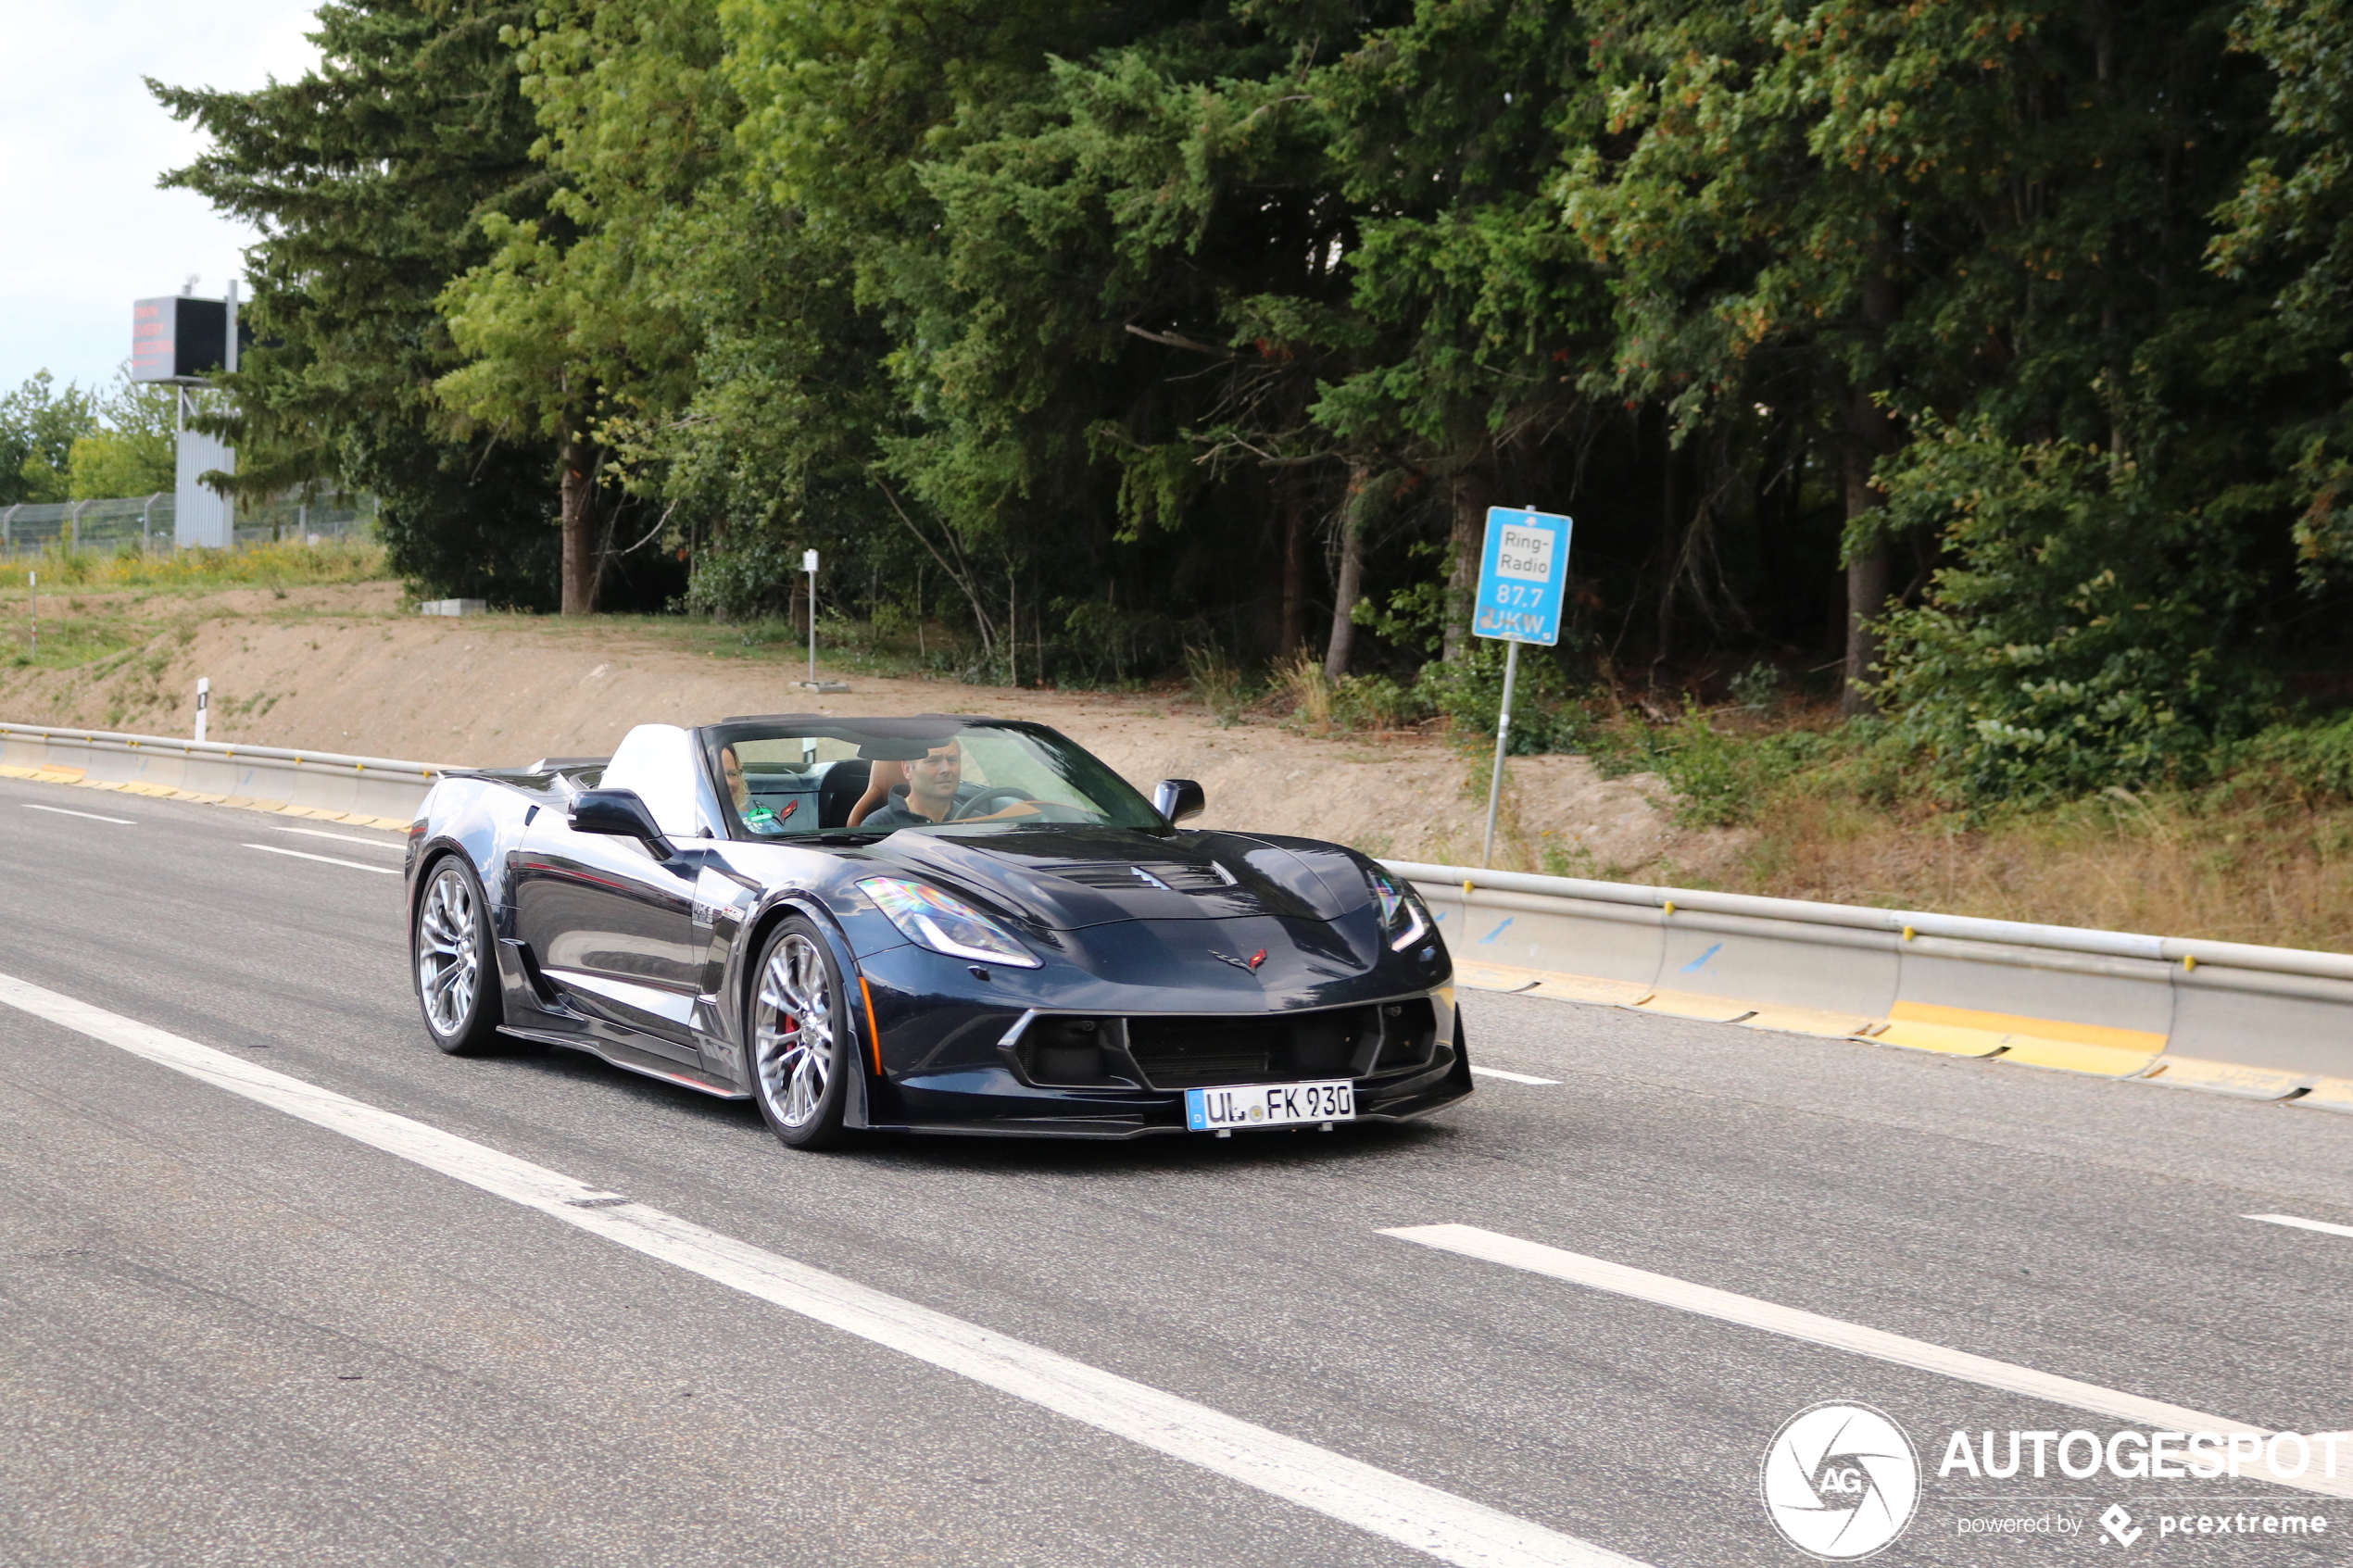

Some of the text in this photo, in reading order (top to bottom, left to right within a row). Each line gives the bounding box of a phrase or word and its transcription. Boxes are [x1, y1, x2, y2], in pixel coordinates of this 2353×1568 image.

[1504, 532, 1550, 553] Ring-
[1501, 554, 1548, 573] Radio
[1496, 584, 1544, 608] 87.7
[1207, 1085, 1351, 1123] UL FK 930
[1194, 1114, 1202, 1123] D
